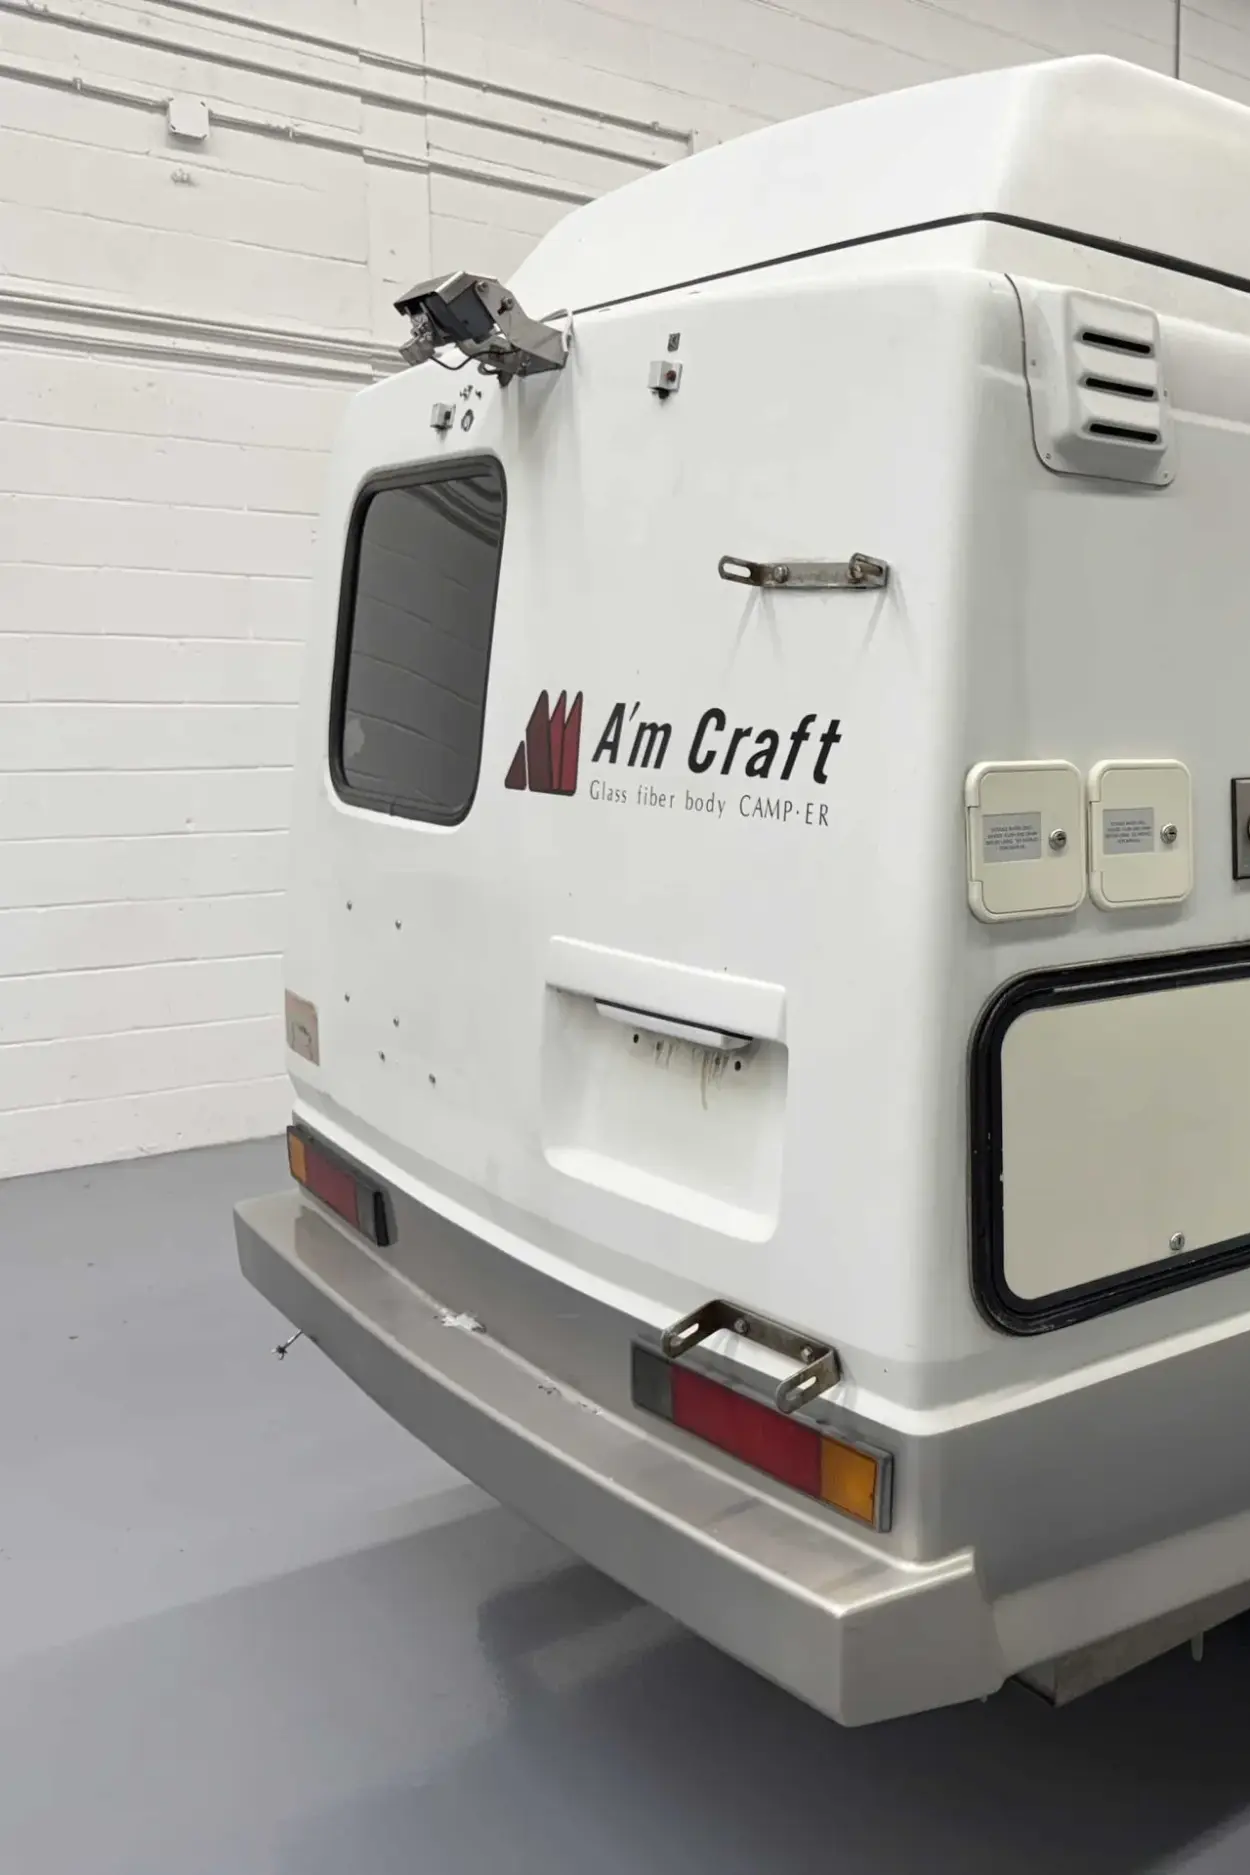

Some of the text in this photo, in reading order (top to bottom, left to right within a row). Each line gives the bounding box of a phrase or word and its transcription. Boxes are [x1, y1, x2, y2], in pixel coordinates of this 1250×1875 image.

[591, 701, 842, 784] A'm Craft
[590, 780, 627, 804] Glass
[637, 784, 675, 809] fiber
[685, 789, 726, 819] body
